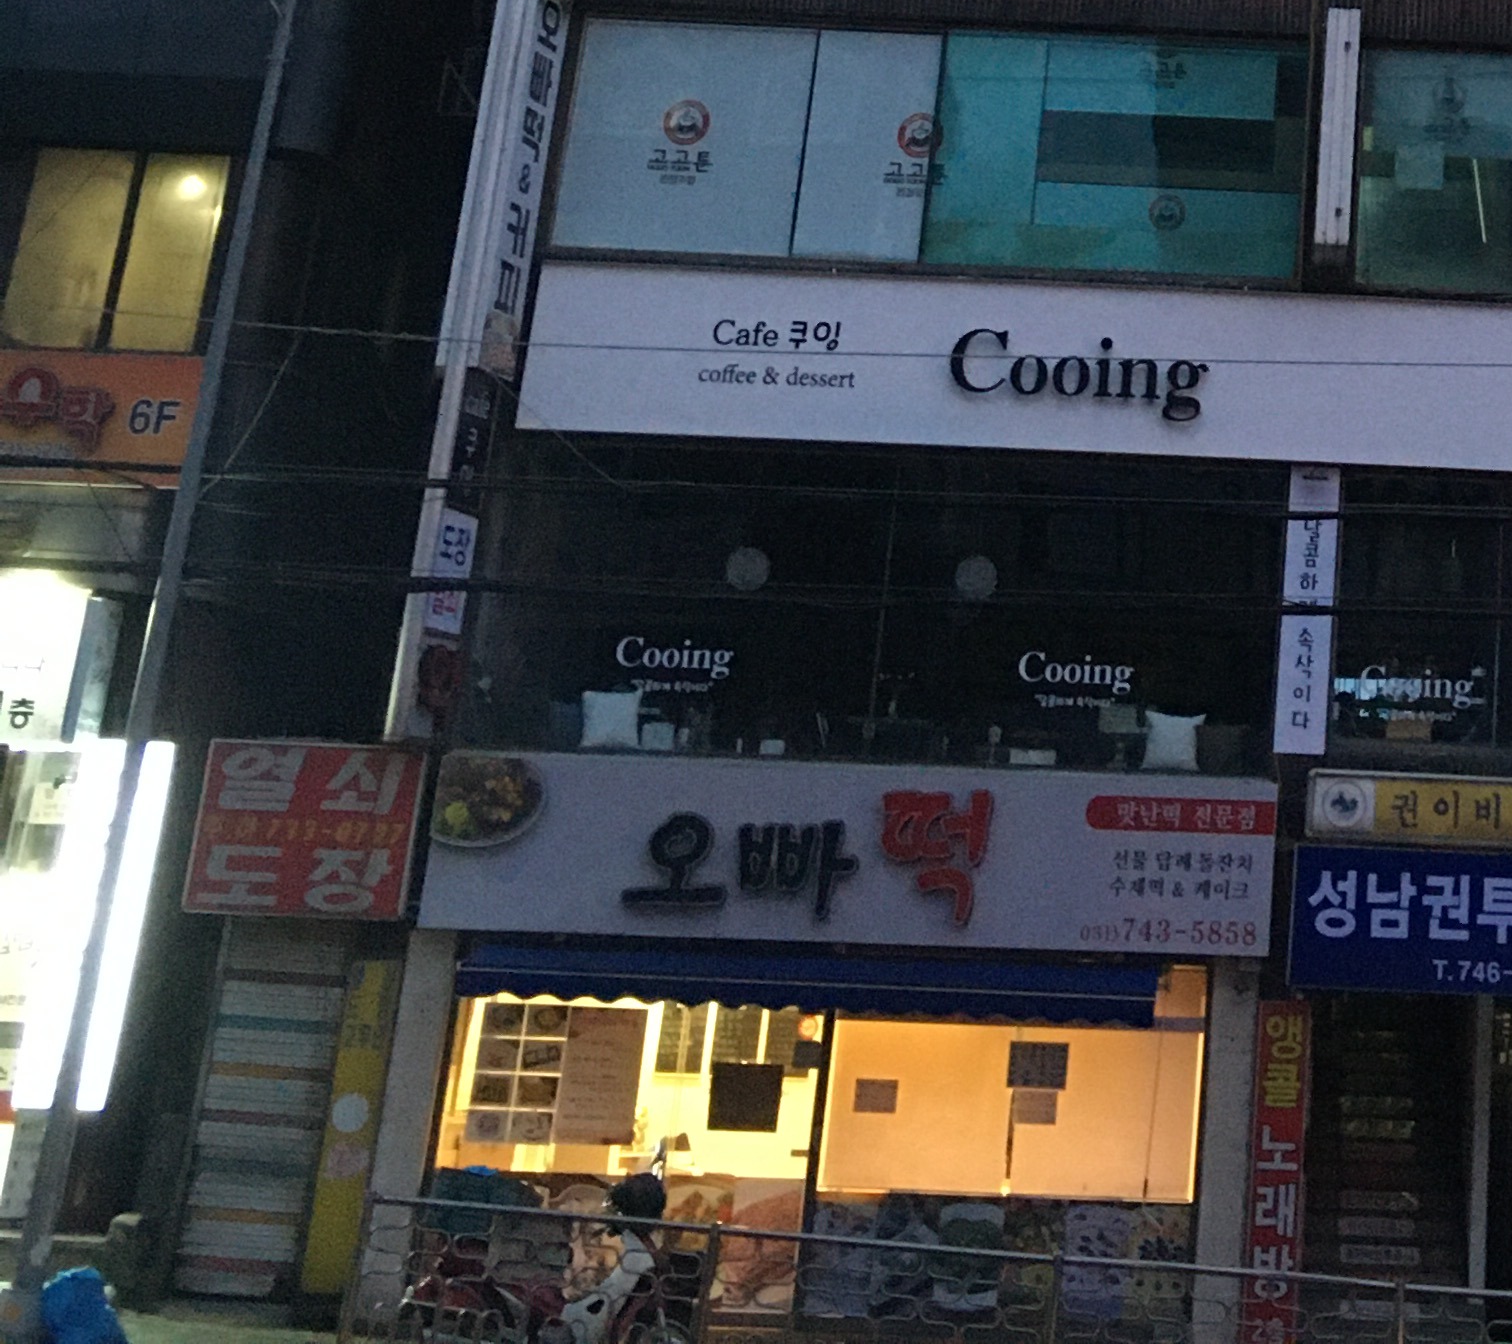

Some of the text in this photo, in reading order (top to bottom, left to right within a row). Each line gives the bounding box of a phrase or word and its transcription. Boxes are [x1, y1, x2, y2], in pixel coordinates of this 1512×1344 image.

[711, 318, 781, 351] Cafe
[787, 320, 843, 352] 쿠잉
[697, 362, 856, 390] coffee & dessert
[949, 328, 1210, 423] Cooing
[126, 398, 181, 436] 6F
[615, 636, 735, 680] Cooing
[1018, 650, 1136, 695] Cooing
[1290, 627, 1316, 730] 속삭이다
[218, 746, 408, 815] 열쇠
[1195, 803, 1257, 830] 전문점
[196, 844, 394, 912] 도장
[620, 788, 996, 928] 오빠떡
[1172, 881, 1184, 898] &
[1263, 1015, 1302, 1109] 앵콜
[1253, 1125, 1298, 1301] 노래방
